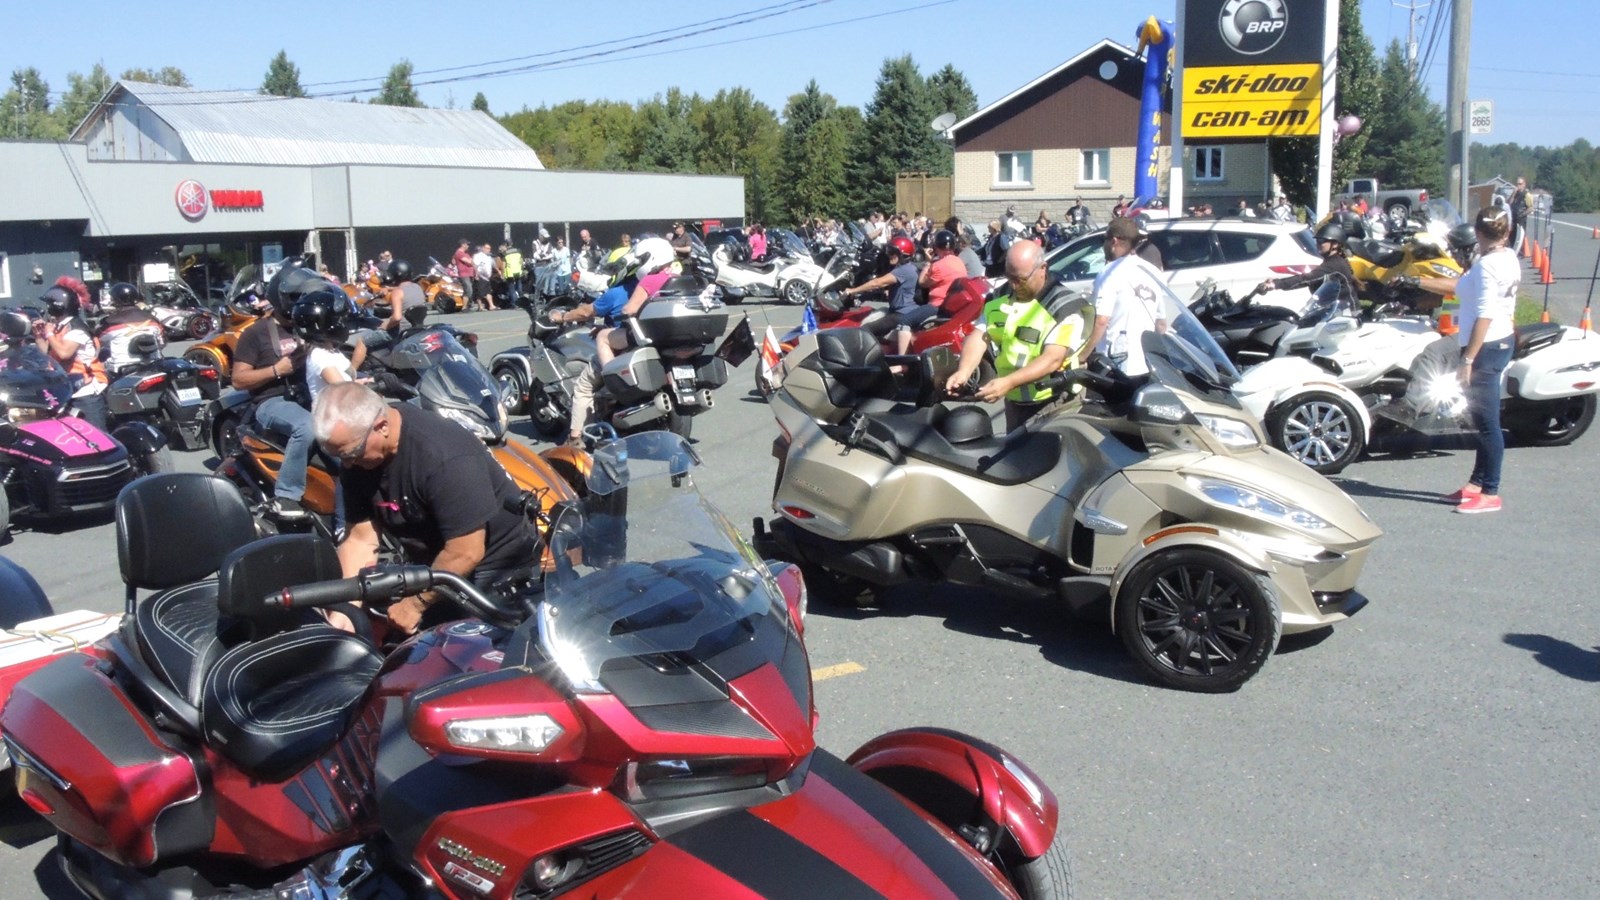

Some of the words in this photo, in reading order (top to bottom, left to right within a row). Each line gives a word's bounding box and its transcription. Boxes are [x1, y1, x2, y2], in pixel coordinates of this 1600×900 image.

[1246, 21, 1284, 33] BRP
[1194, 73, 1309, 95] ski-doo
[1191, 109, 1309, 128] can-am
[1472, 116, 1490, 127] 2665
